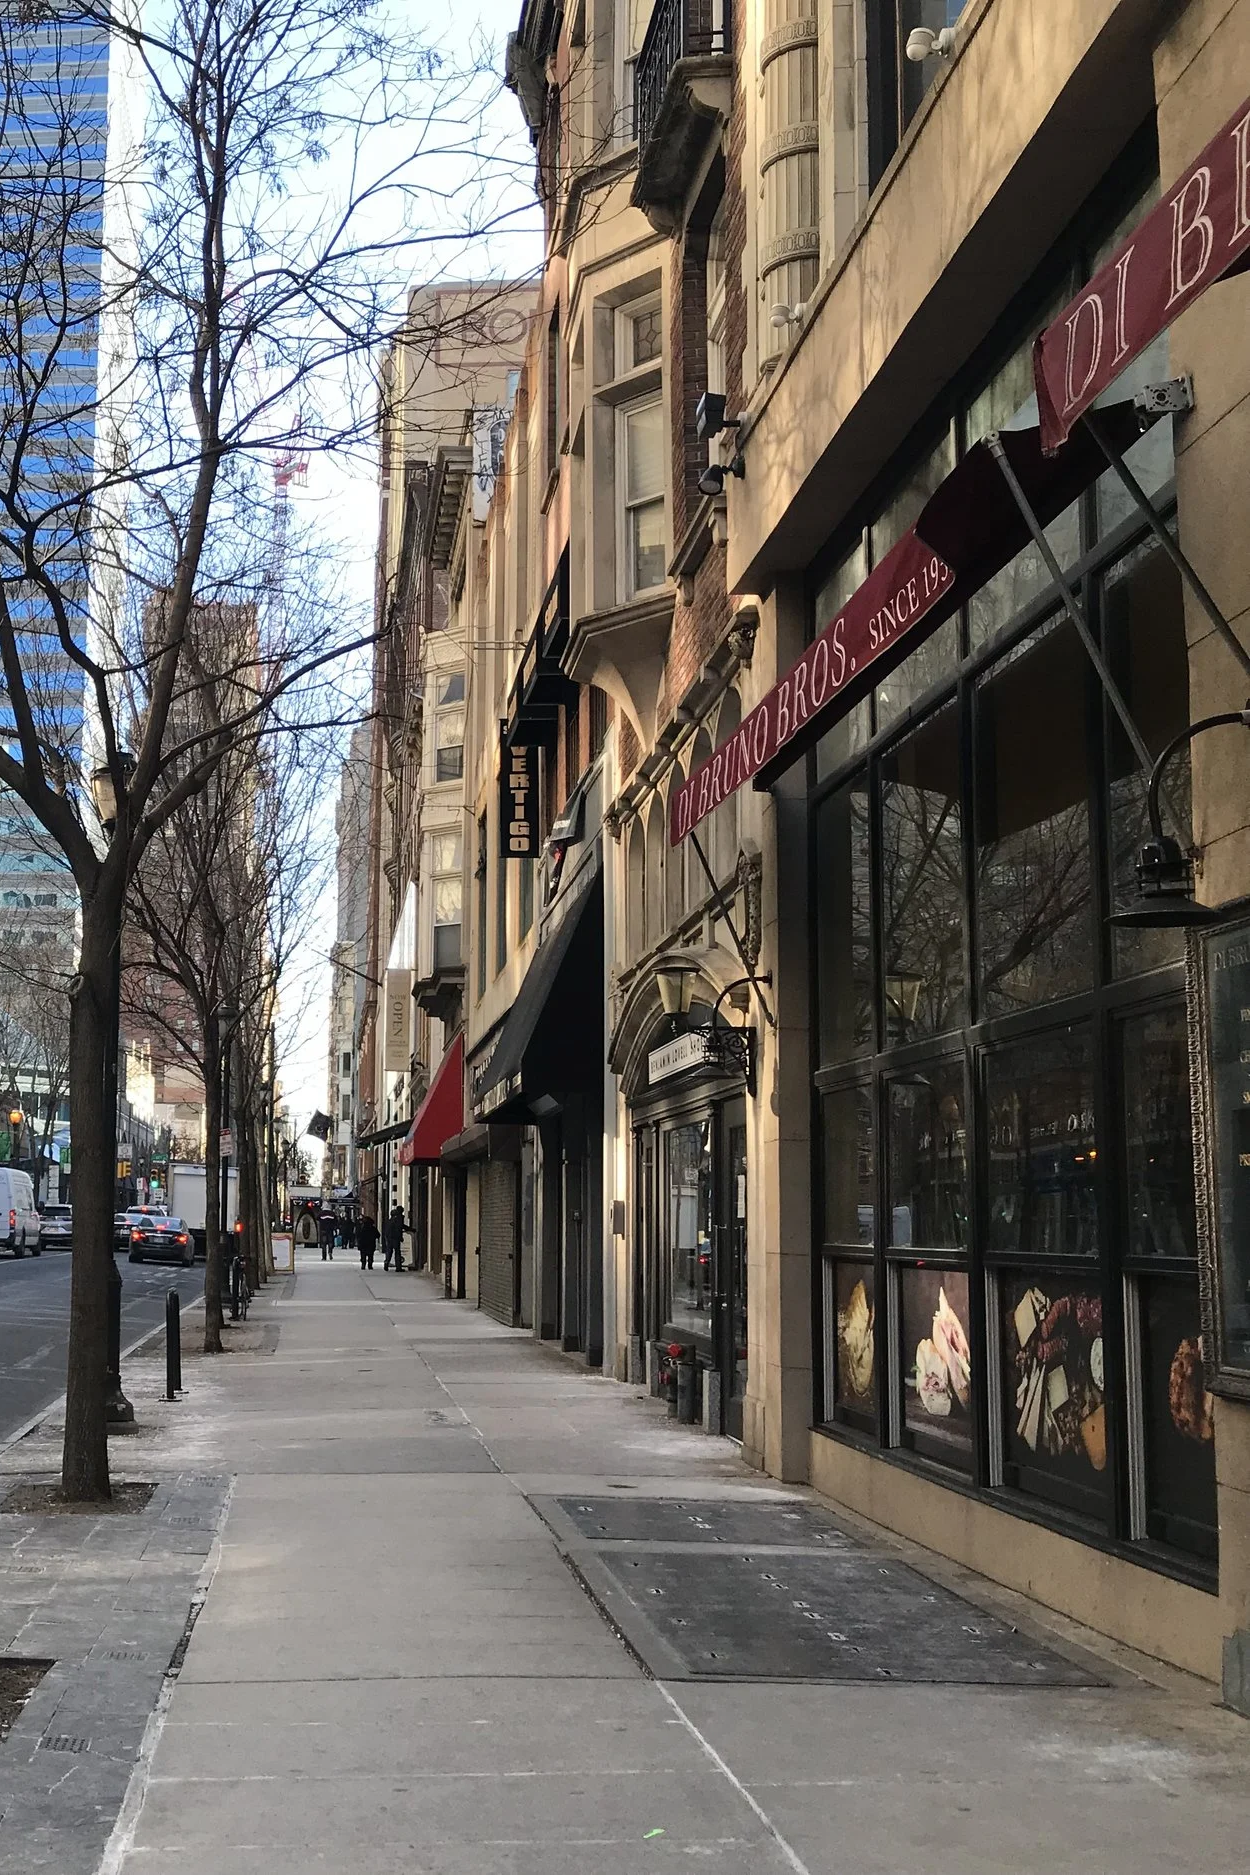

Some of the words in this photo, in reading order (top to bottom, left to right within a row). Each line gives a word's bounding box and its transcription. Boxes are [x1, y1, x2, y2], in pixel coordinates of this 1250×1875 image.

[1062, 244, 1135, 417] DI
[678, 780, 695, 838] DI
[696, 704, 768, 821] BRUNO
[776, 617, 856, 746] BROS.
[868, 576, 920, 650] SINCE
[921, 556, 951, 599] 193
[509, 746, 530, 852] VERTIGO
[393, 1002, 404, 1037] OPEN
